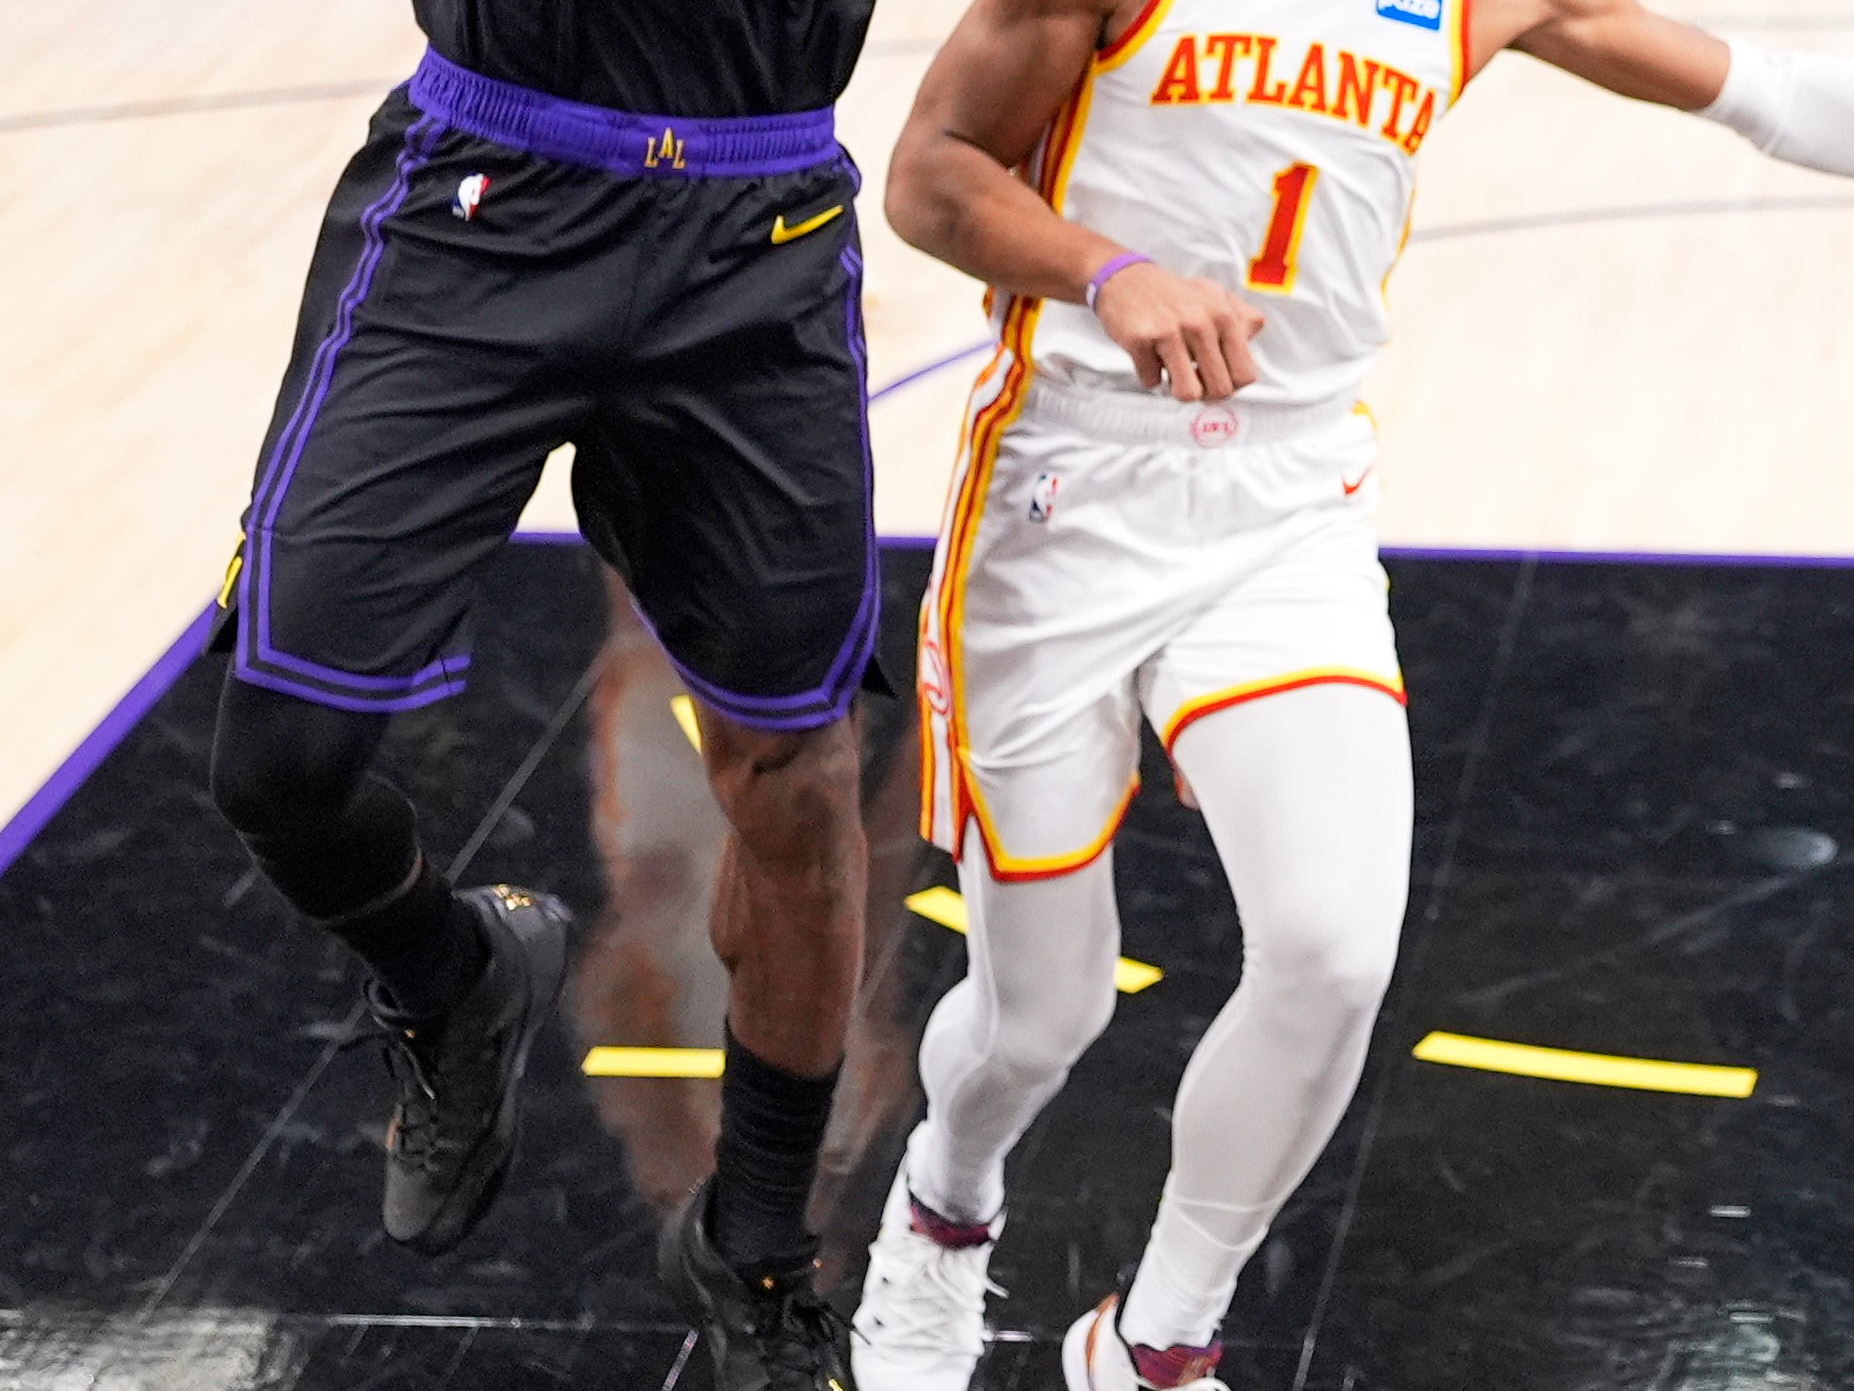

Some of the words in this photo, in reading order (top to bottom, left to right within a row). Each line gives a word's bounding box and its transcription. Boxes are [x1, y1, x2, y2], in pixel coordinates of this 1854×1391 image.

[643, 126, 687, 169] LAL
[1150, 32, 1438, 158] ATLANTA
[1245, 158, 1322, 296] 1
